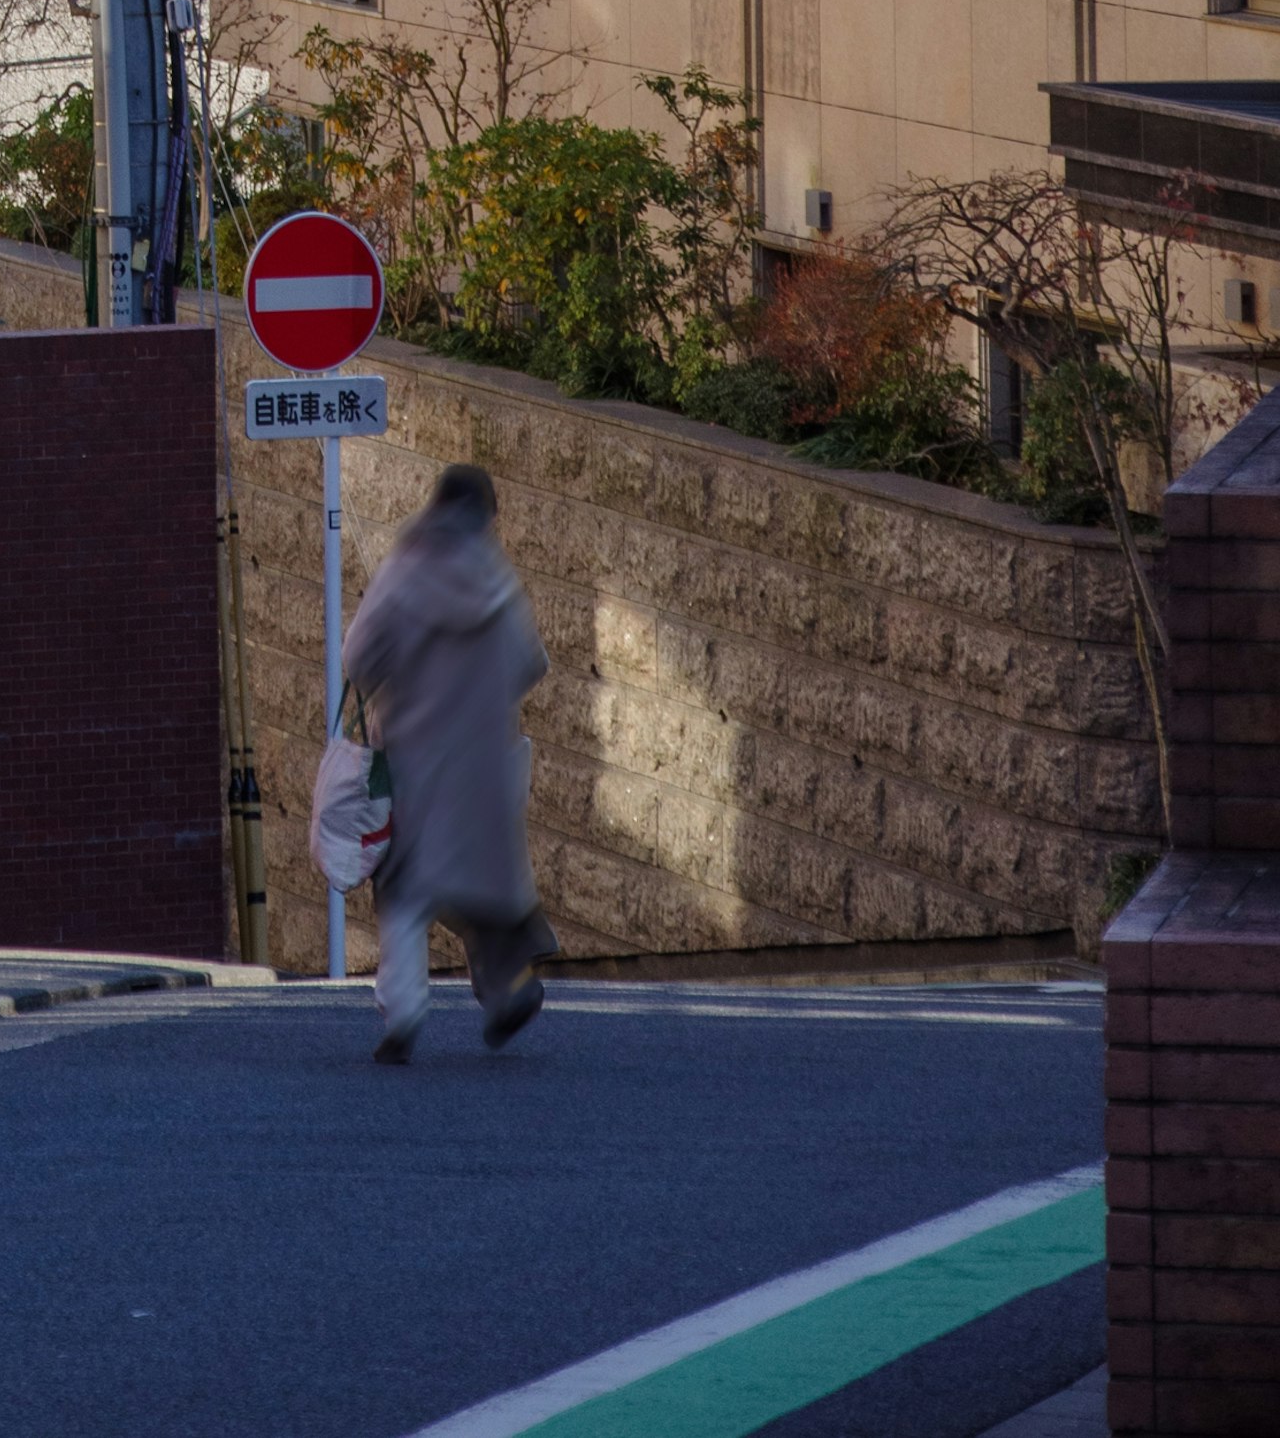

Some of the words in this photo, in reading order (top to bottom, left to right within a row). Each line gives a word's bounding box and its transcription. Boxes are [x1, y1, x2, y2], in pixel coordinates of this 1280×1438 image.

[255, 390, 378, 426] 自転車を除く
